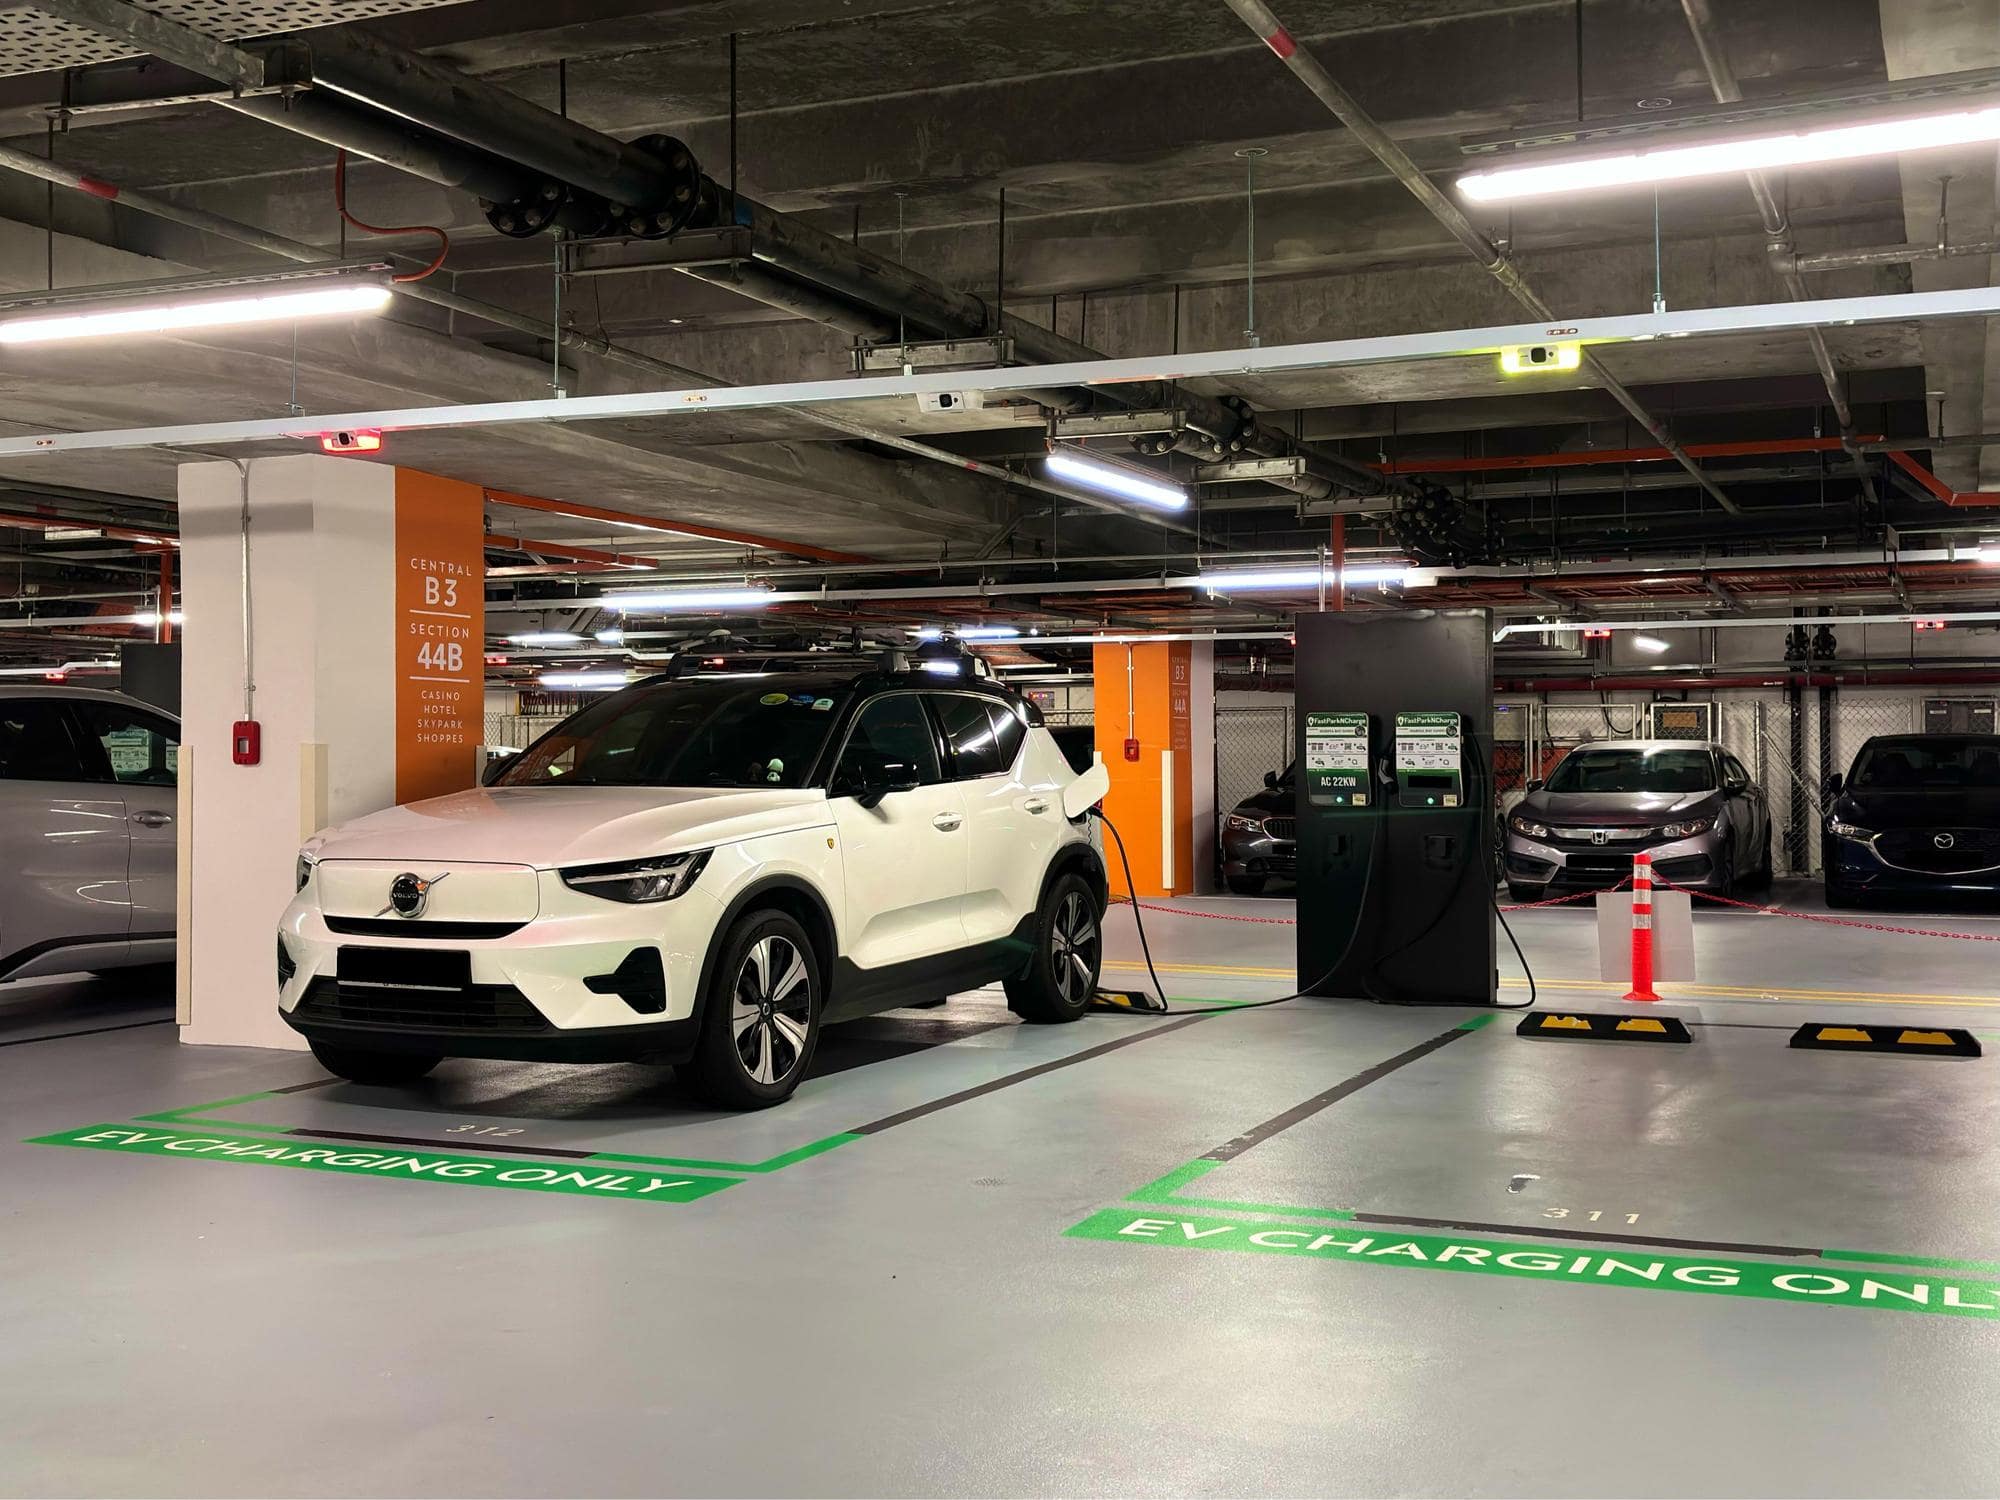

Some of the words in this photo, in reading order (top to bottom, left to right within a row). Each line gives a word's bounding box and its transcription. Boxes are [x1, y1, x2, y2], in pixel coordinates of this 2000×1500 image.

[410, 558, 472, 577] CENTRAL
[425, 576, 457, 607] B3
[410, 622, 469, 639] SECTION
[417, 641, 463, 672] 44B
[421, 690, 460, 701] CASINO
[423, 705, 457, 715] HOTEL
[417, 718, 463, 730] SKYPARK
[417, 733, 464, 744] SHOPPES
[1321, 776, 1332, 787] AC
[1333, 776, 1357, 788] 22KW
[445, 1124, 525, 1137] 312
[73, 1130, 167, 1146] EV
[164, 1138, 496, 1177] CHARGING
[496, 1168, 694, 1193] ONLY
[1541, 1207, 1641, 1225] 311
[1117, 1218, 1237, 1241] EV
[1248, 1231, 1742, 1287] CHARGING
[1771, 1273, 2000, 1310] ONL
